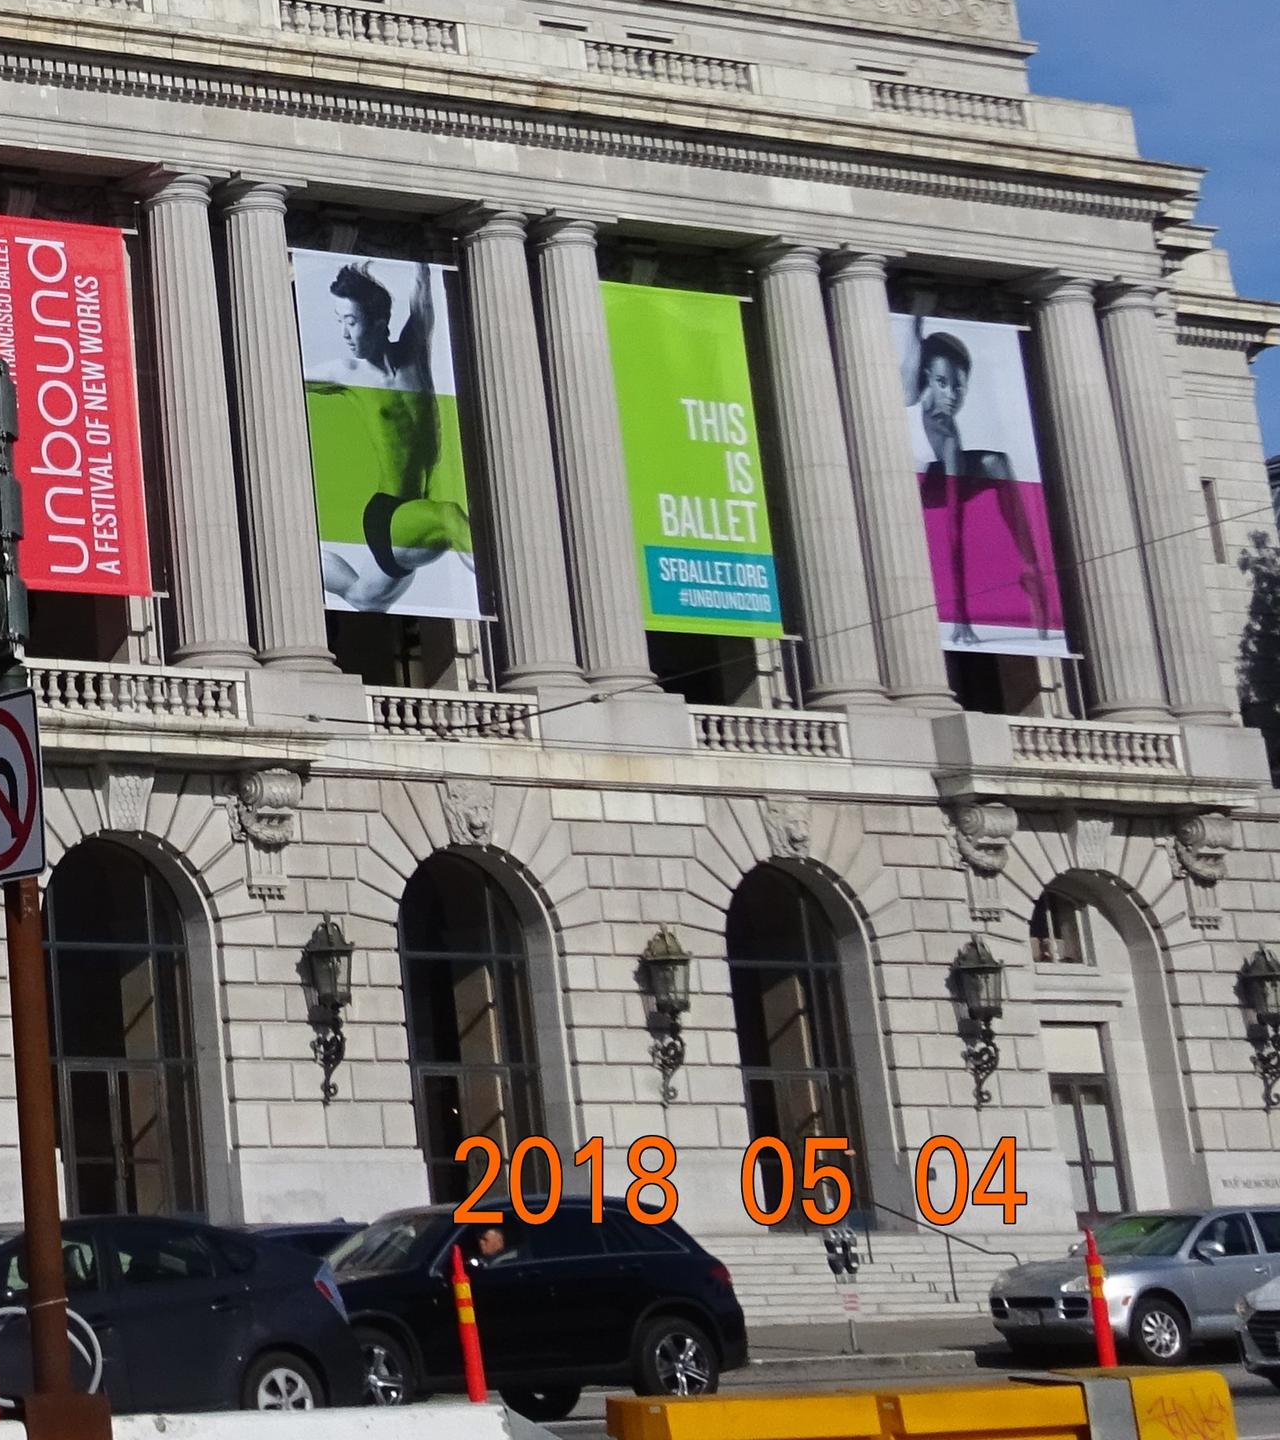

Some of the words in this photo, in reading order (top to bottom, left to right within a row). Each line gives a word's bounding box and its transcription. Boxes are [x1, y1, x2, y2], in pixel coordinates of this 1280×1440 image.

[73, 274, 104, 354] WORKS
[14, 236, 90, 574] unbound
[81, 359, 109, 410] NEW
[84, 415, 112, 446] OF
[680, 397, 748, 446] THIS
[725, 450, 755, 495] IS
[88, 452, 120, 553] FESTIVAL
[658, 492, 758, 544] BALLET
[95, 559, 121, 575] A
[658, 556, 769, 589] SFBALLET.ORG
[679, 588, 772, 613] #UNBOUND2018
